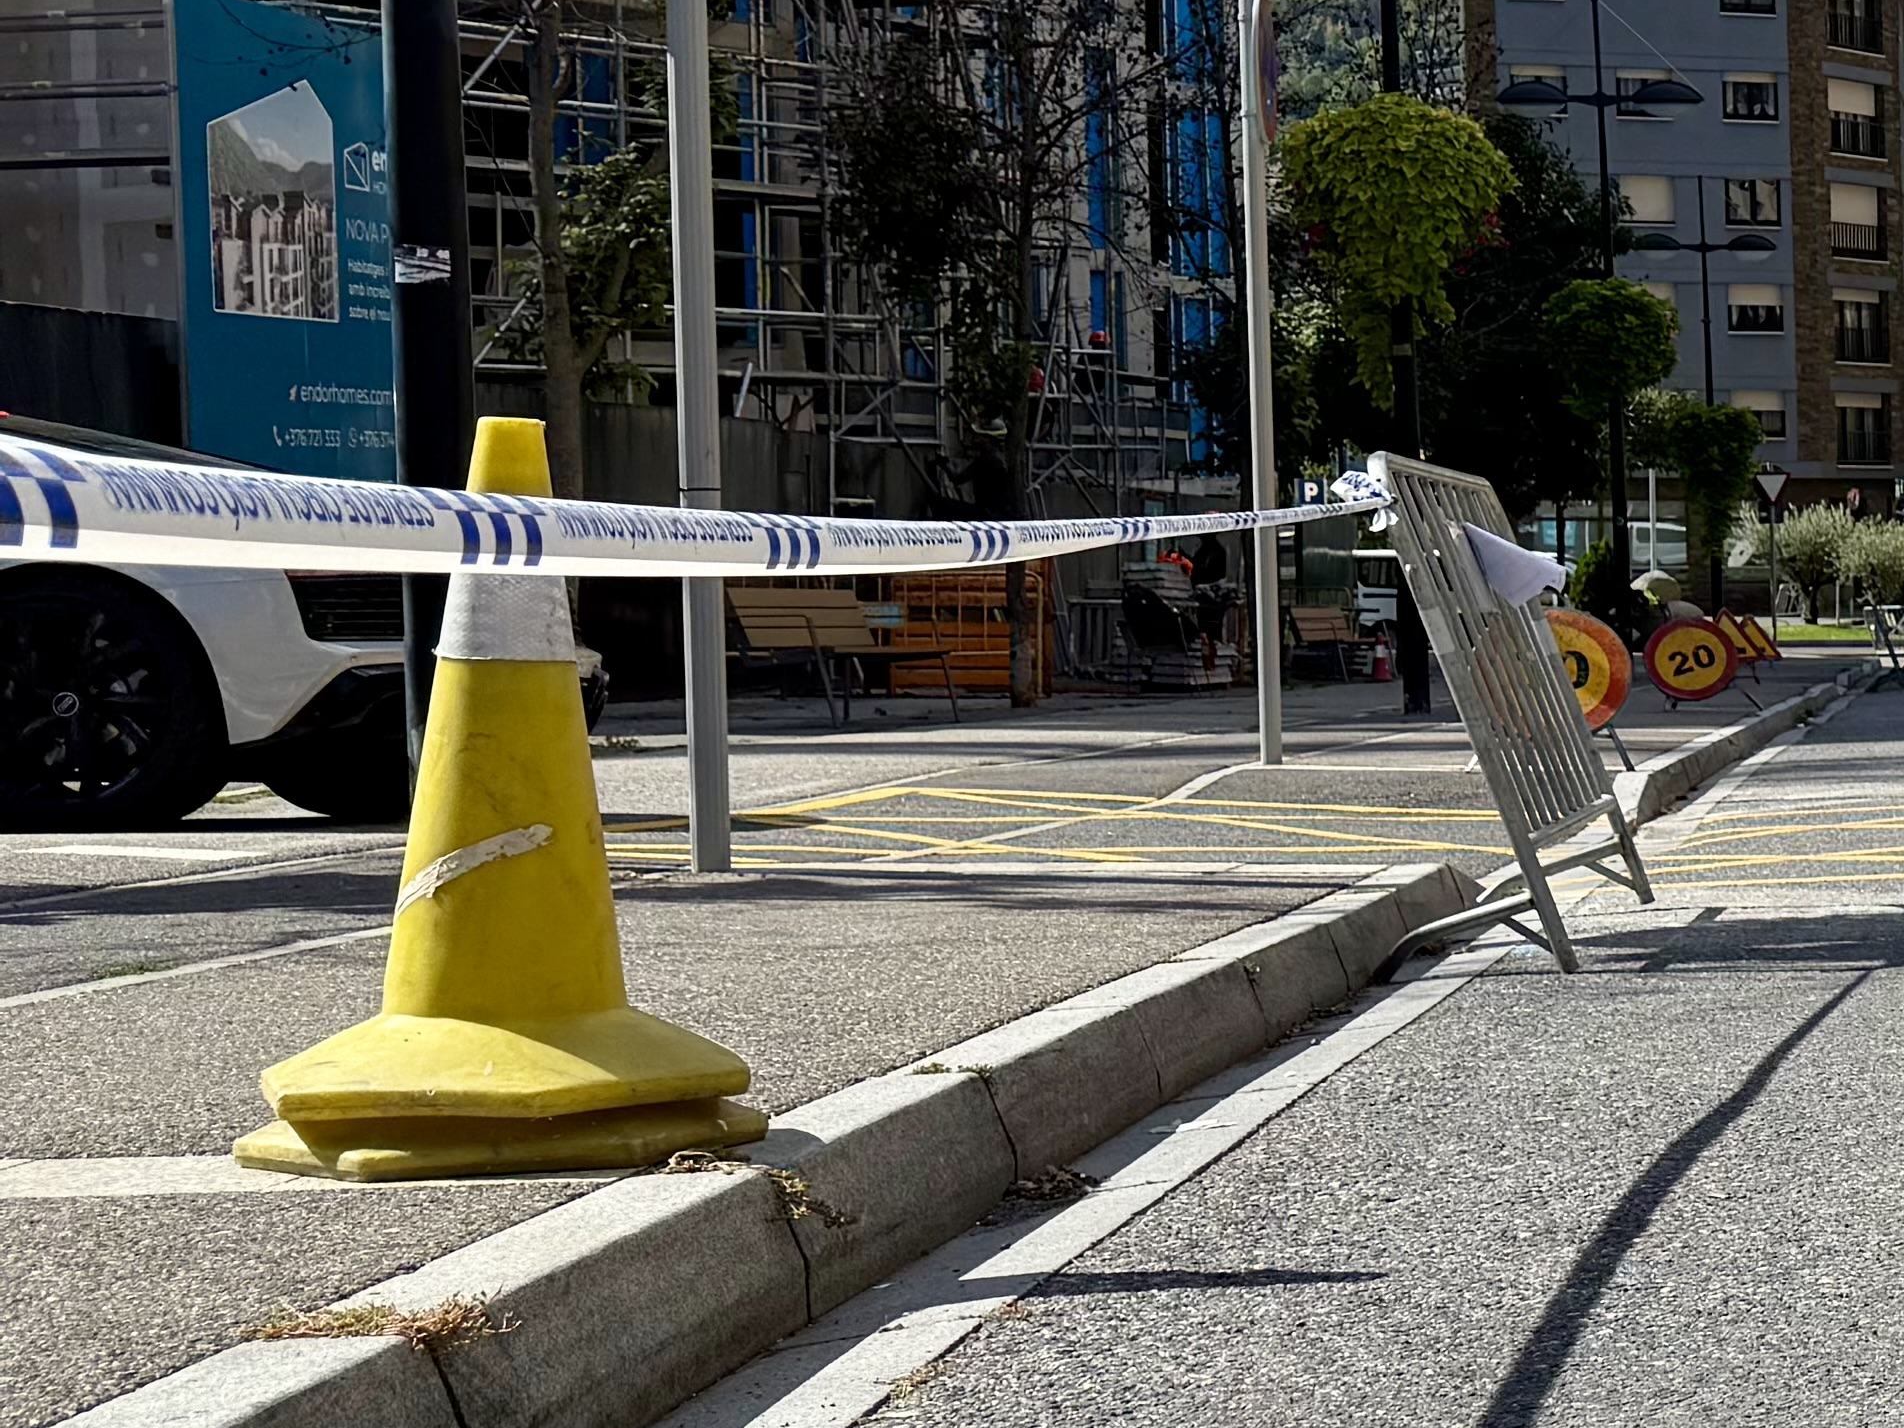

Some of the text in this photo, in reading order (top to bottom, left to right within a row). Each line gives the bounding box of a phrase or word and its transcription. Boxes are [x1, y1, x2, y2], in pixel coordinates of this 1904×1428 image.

[346, 218, 379, 243] NOVA
[300, 380, 392, 406] endorhomes.com
[1304, 482, 1319, 502] P
[1668, 644, 1715, 677] 20
